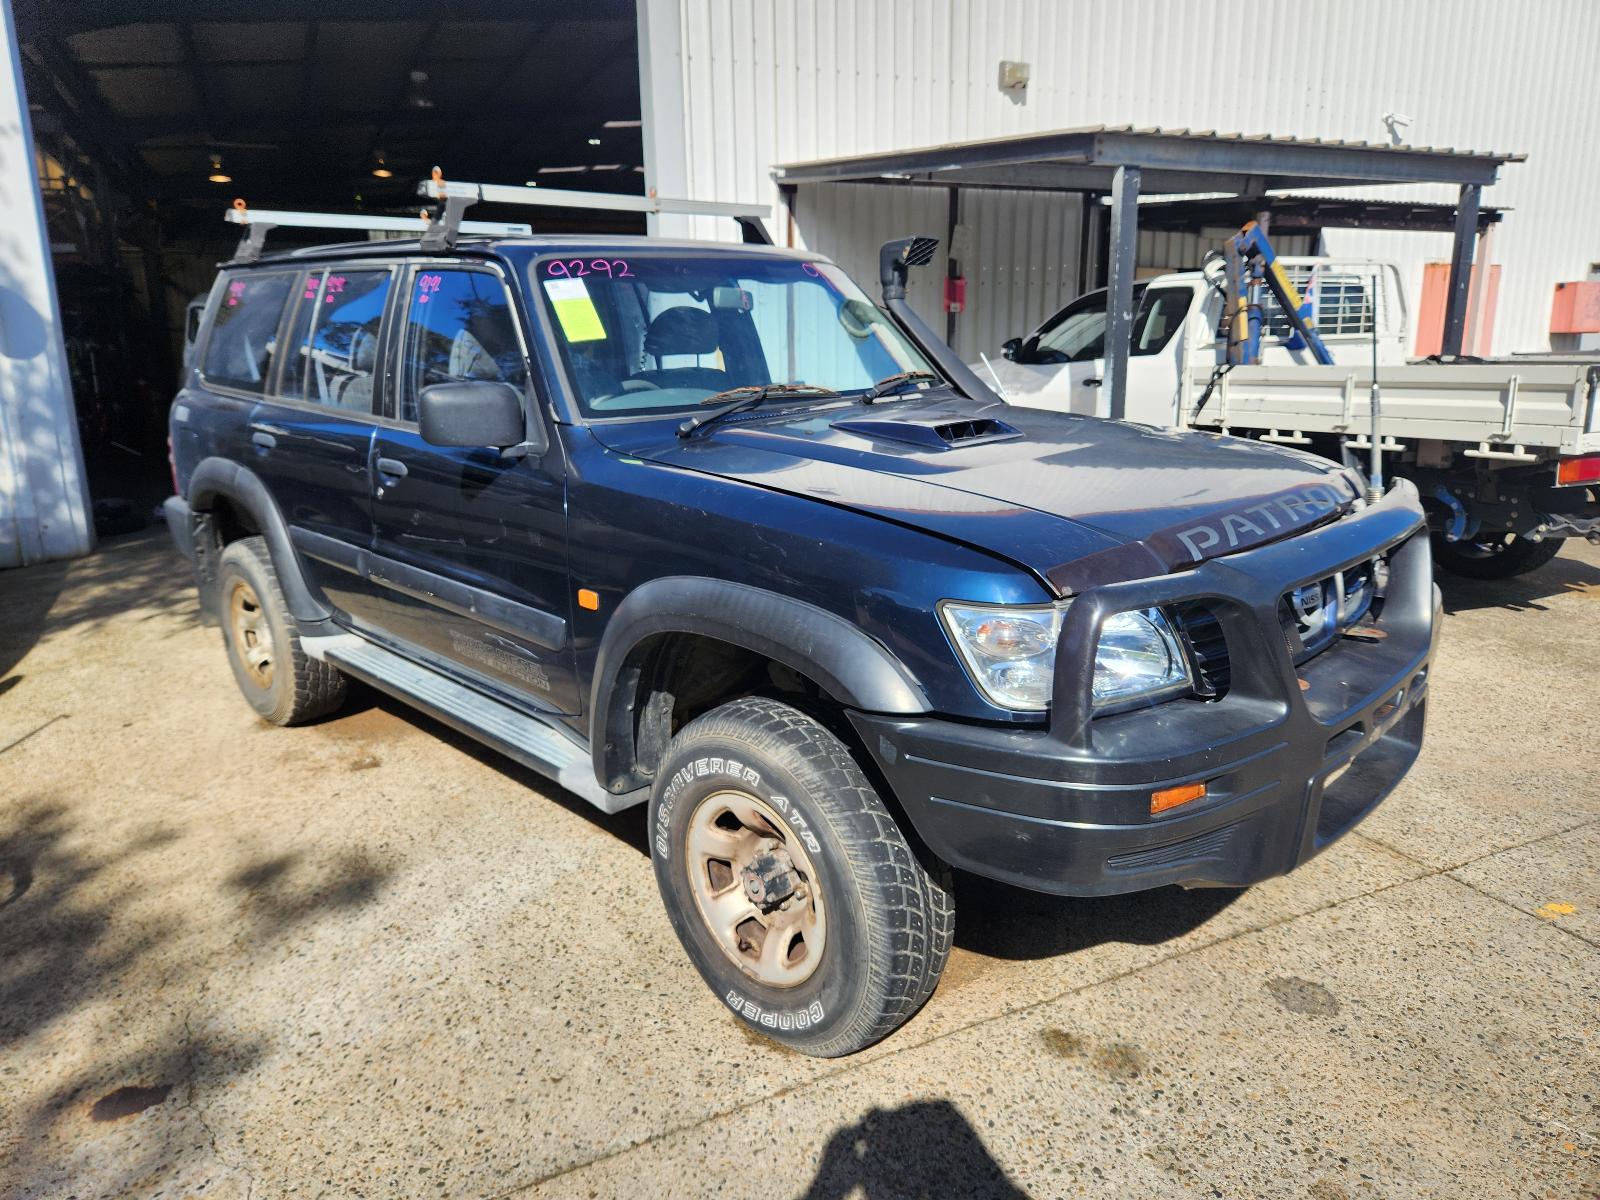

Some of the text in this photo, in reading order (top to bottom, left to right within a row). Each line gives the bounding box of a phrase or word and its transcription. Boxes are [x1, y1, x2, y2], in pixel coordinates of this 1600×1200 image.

[548, 259, 635, 280] 9292
[1176, 485, 1346, 562] PATROL
[656, 757, 760, 859] DISCOVERER
[726, 990, 825, 1030] COOPER
